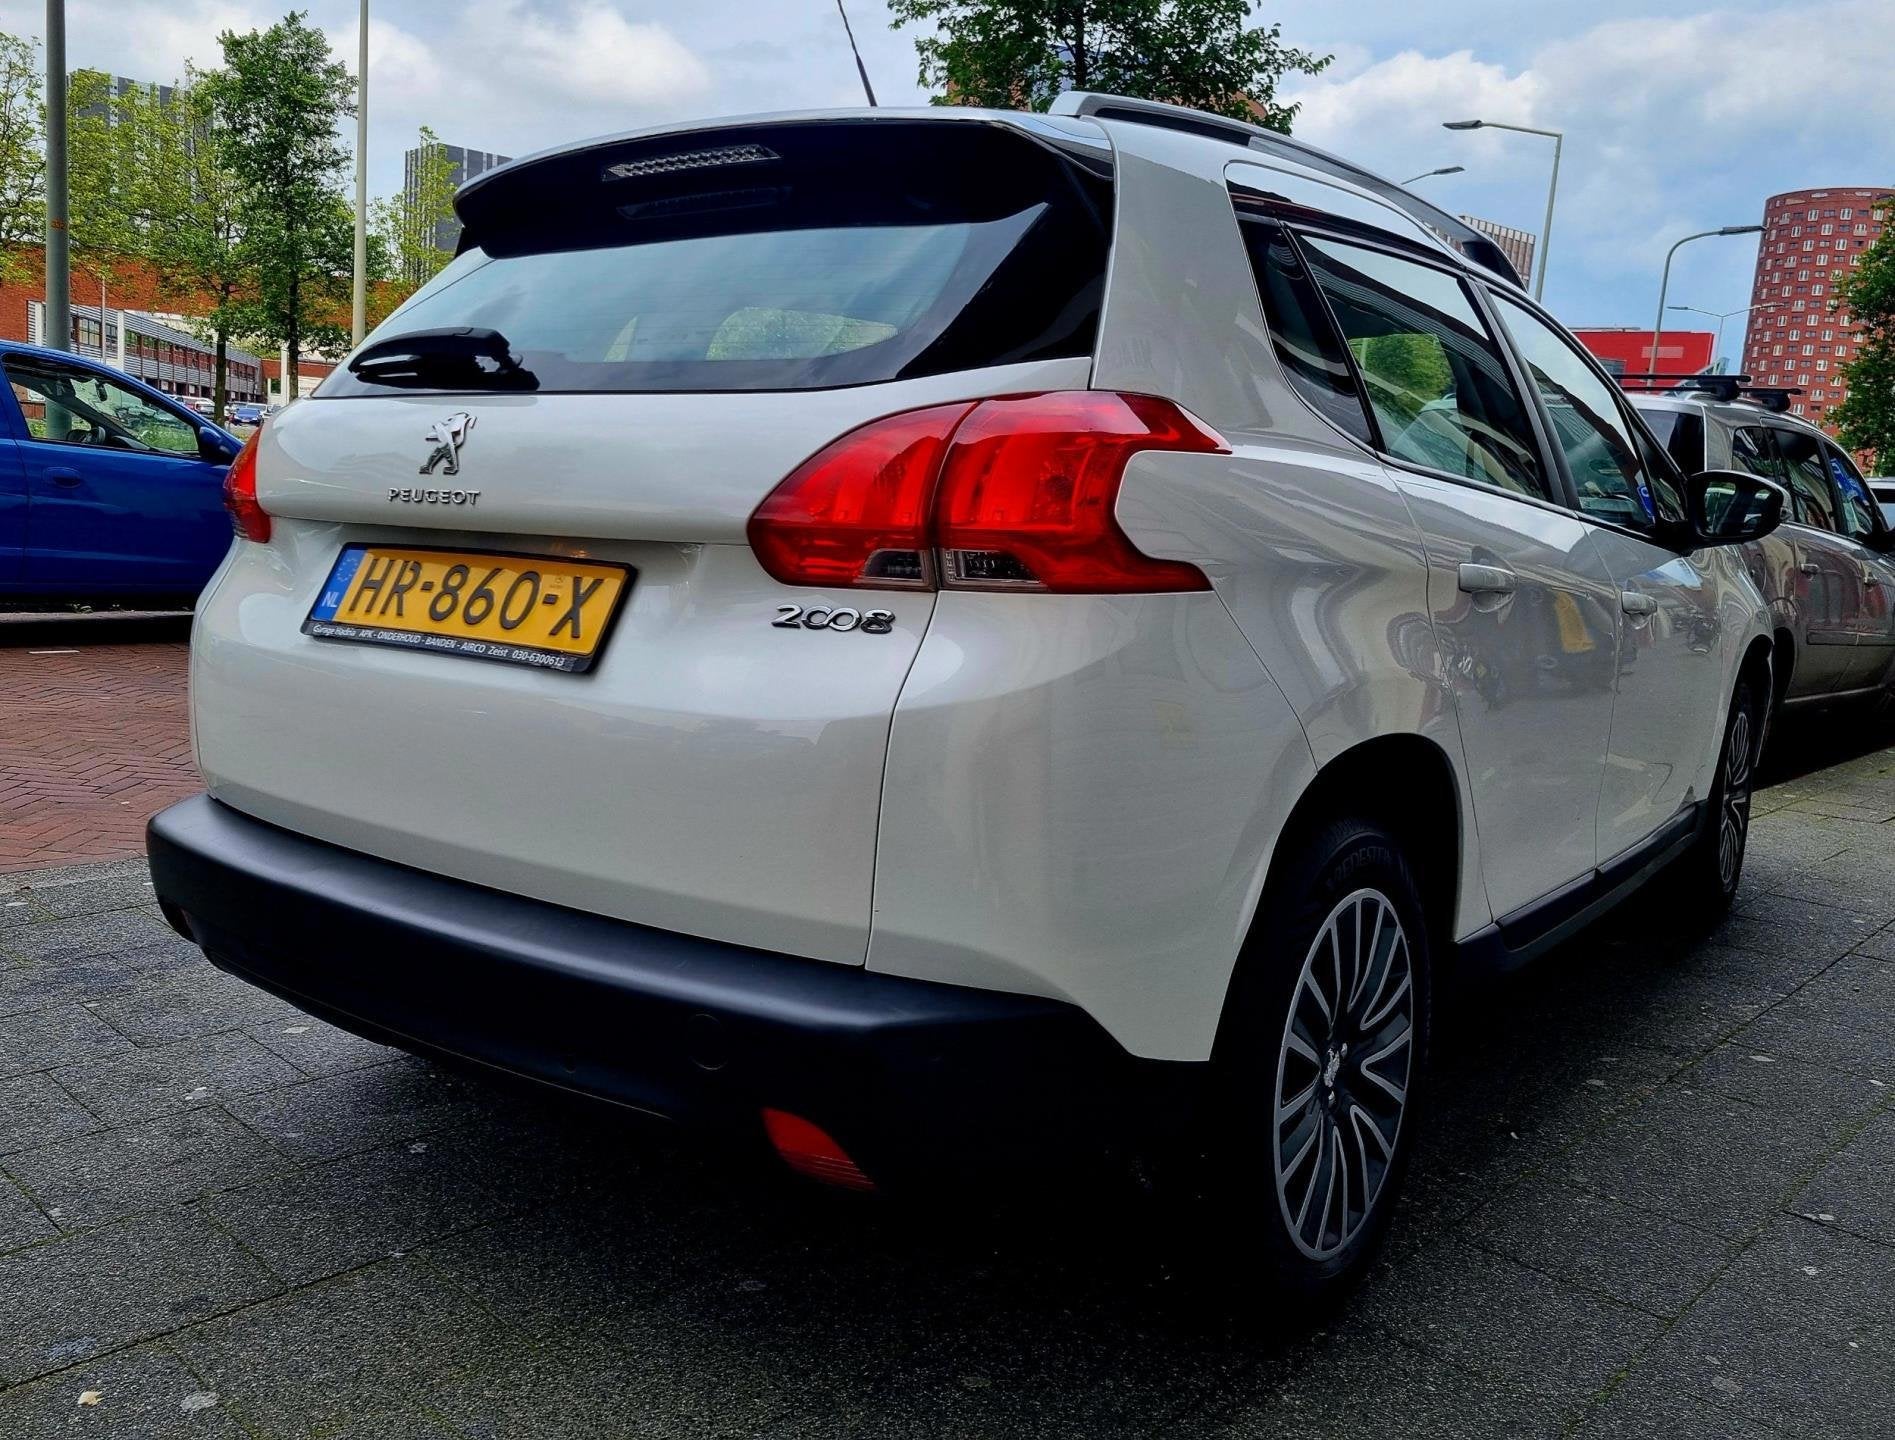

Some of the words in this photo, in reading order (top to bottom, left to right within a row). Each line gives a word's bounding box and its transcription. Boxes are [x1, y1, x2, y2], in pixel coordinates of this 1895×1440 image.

[387, 487, 481, 505] PEUGEOT
[321, 592, 340, 608] NL
[348, 558, 604, 639] HR-860-X
[771, 604, 896, 634] 2008
[313, 624, 335, 636] Garage
[377, 631, 421, 644] ONDERHOUD
[425, 636, 457, 648] BANDEN
[460, 641, 486, 653] AIRCO
[488, 645, 508, 657] Zeist
